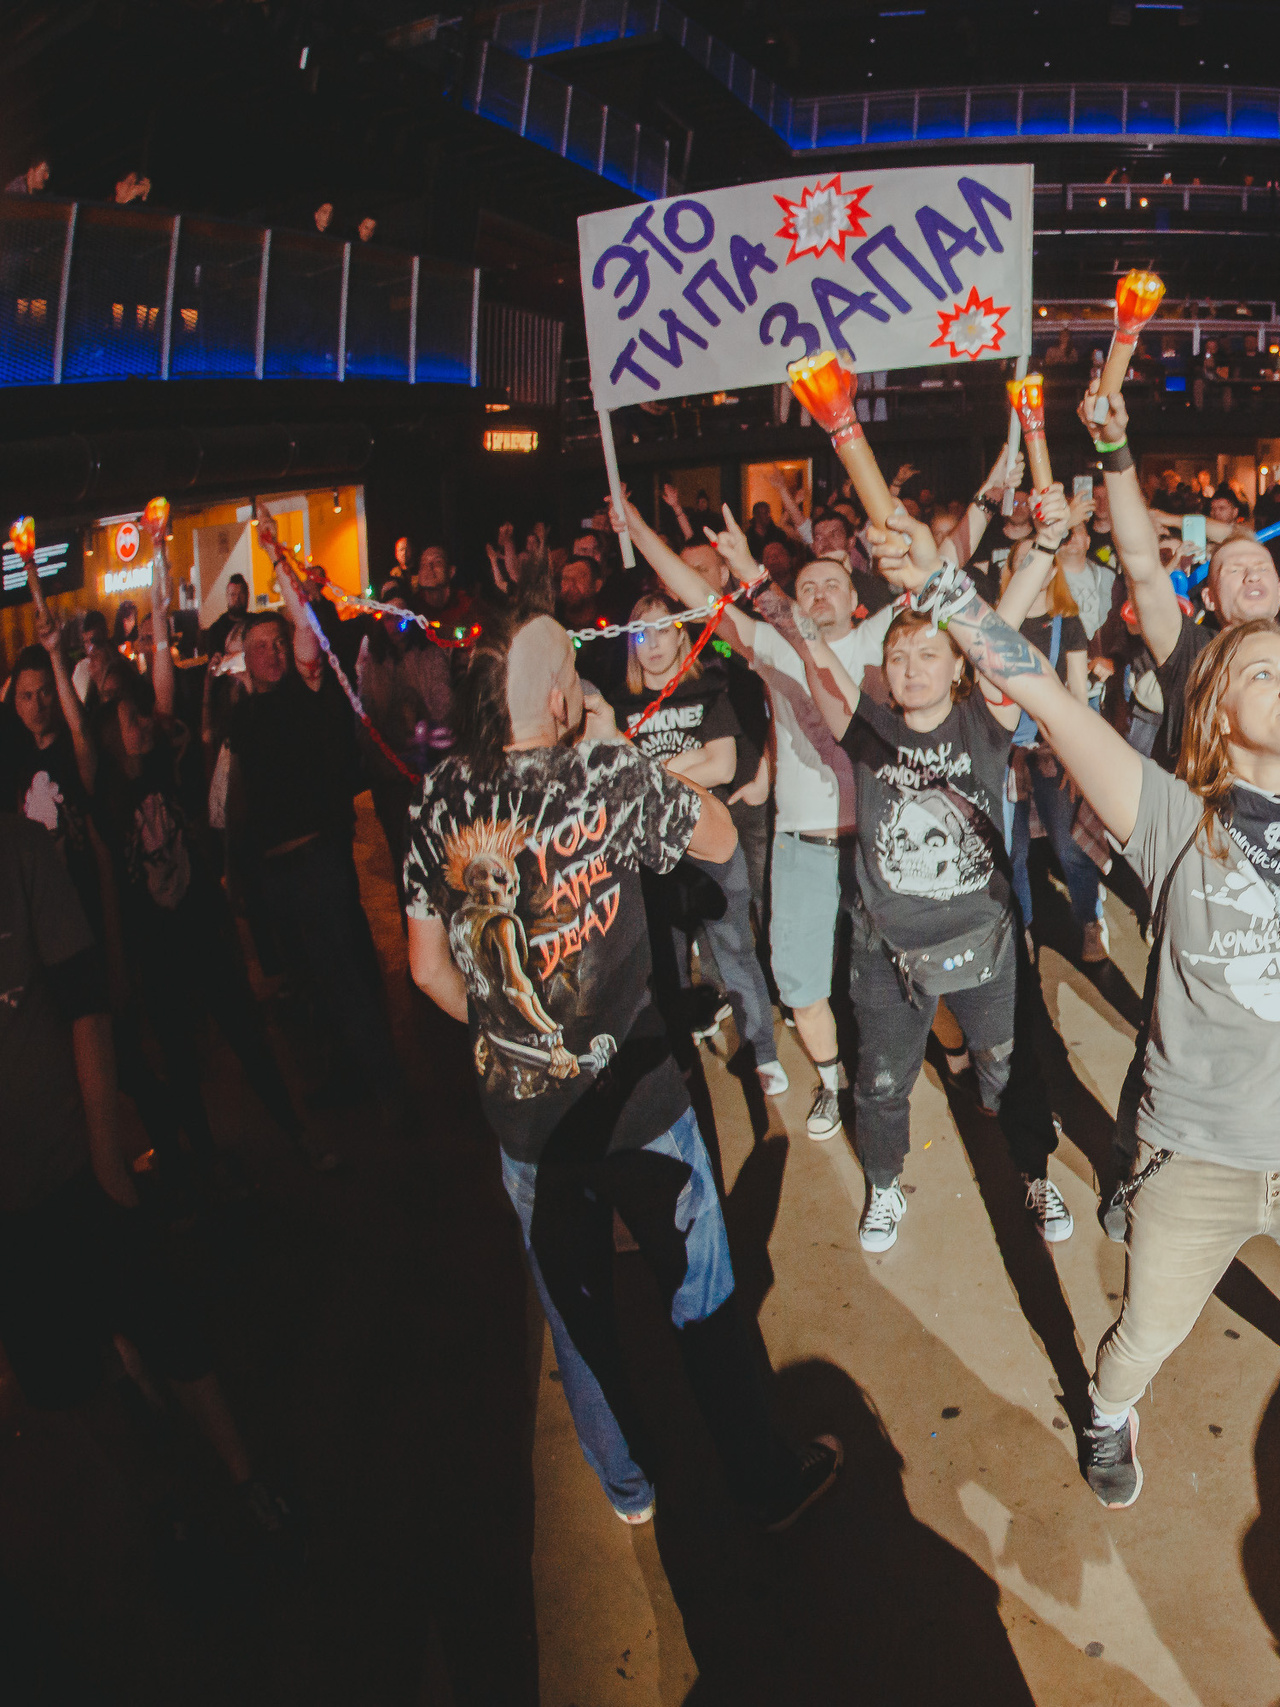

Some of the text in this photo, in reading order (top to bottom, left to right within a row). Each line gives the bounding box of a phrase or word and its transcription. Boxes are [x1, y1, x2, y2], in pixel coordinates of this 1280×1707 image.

[592, 199, 716, 321] ЭТО
[609, 234, 778, 392] ТИПА
[758, 176, 1013, 371] ЗАПАЛ
[525, 799, 608, 885] YOU
[543, 849, 612, 913] ARE
[529, 883, 621, 980] DEAD
